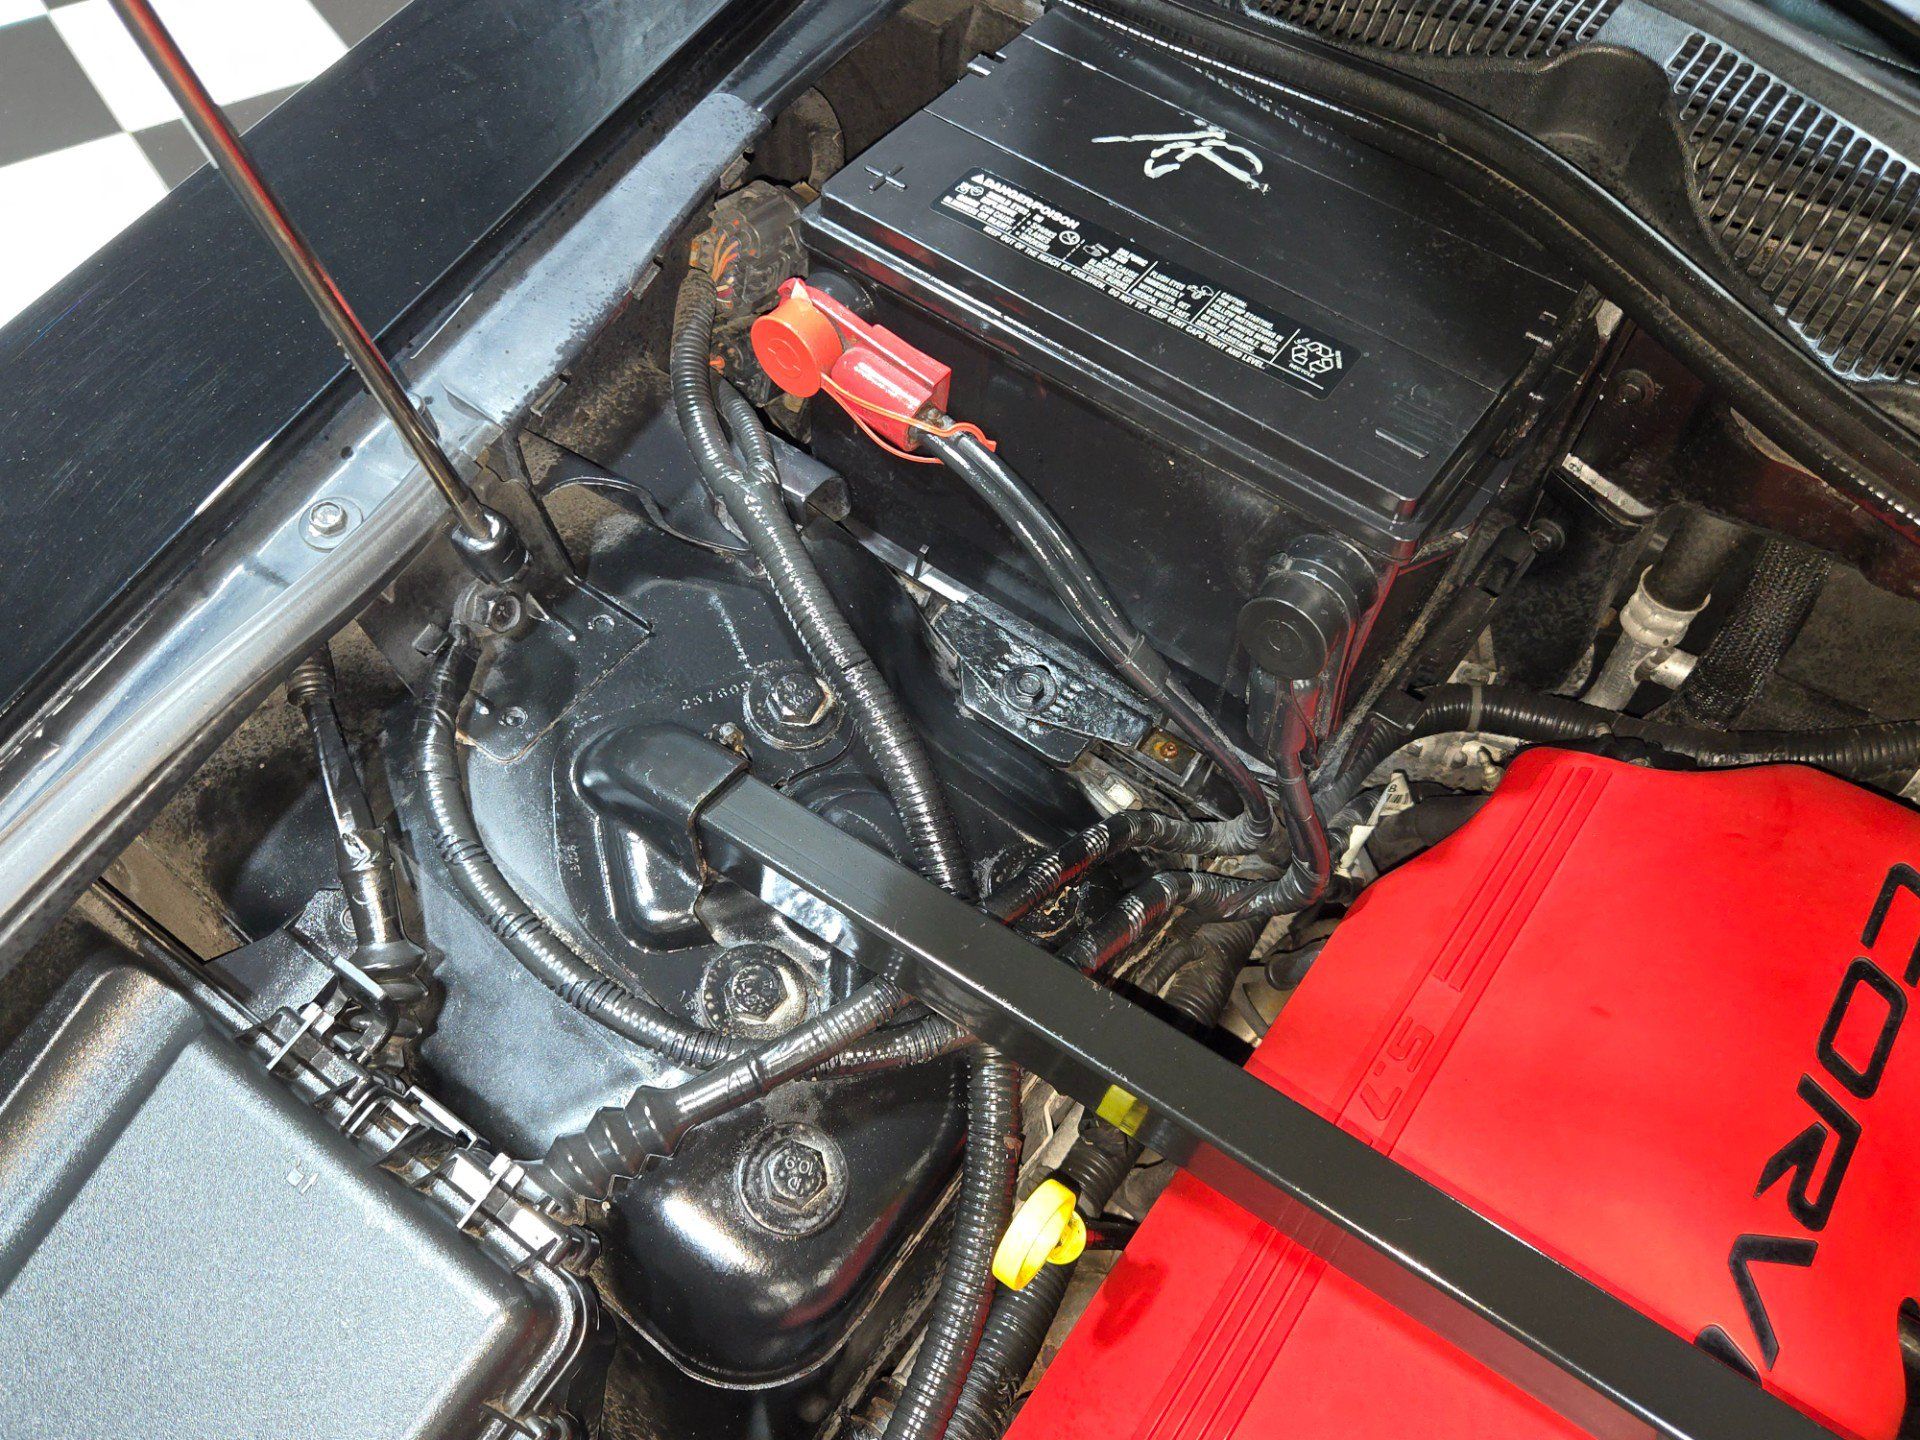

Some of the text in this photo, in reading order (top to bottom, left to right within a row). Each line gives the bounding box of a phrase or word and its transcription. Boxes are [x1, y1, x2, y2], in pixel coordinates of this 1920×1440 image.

[993, 211, 1016, 225] CAUSE
[1025, 227, 1051, 244] FLAMES
[1102, 258, 1139, 279] CAN CAUSE
[1150, 271, 1186, 290] FLUSH EYES
[983, 226, 1002, 236] KEEP
[1000, 234, 1016, 245] OUT
[1014, 242, 1026, 250] OF
[1025, 247, 1040, 257] THE
[1037, 253, 1061, 267] REACH
[1108, 288, 1120, 297] DO
[1119, 294, 1136, 305] NOT
[1149, 308, 1168, 319] KEEP
[1167, 316, 1187, 328] VENT
[1186, 326, 1205, 338] CAPS
[1206, 335, 1227, 350] TIGHT
[1226, 347, 1242, 358] AND
[1138, 283, 1155, 294] WITH
[1177, 301, 1191, 310] GET
[1144, 277, 1184, 298] IMMEDIATELY
[1132, 288, 1190, 321] MEDICAL HELP FAST.
[1215, 298, 1229, 307] FOR
[1228, 304, 1245, 315] JUMP
[1195, 319, 1220, 335] SERVICE
[1206, 308, 1230, 324] VEHICLE
[1254, 333, 1278, 348] MANUAL
[1210, 303, 1236, 318] FOLLOW
[1234, 315, 1276, 338] INSTRUCTIONS
[1201, 314, 1211, 322] OR
[1216, 322, 1229, 331] NOT
[1260, 344, 1277, 355] SEEK
[1360, 1016, 1434, 1121] 5.7
